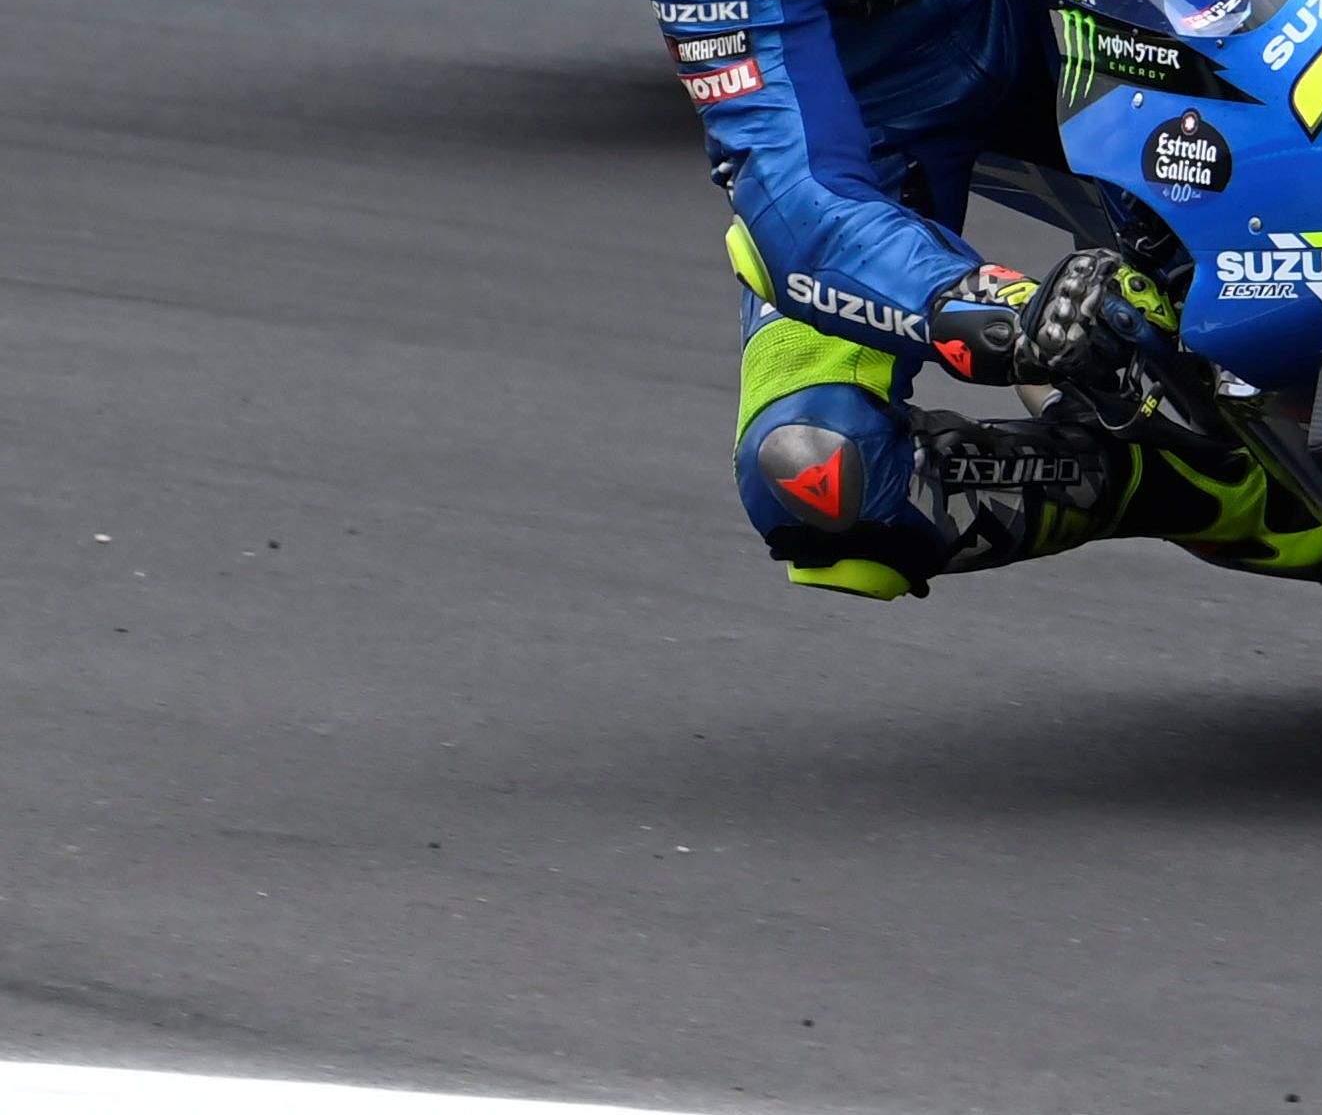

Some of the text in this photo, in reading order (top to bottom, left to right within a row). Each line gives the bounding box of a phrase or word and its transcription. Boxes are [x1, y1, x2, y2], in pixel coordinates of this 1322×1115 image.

[652, 0, 750, 23] SUZUKI
[1097, 33, 1181, 70] MONSTER
[1109, 62, 1167, 81] ENERGY
[1155, 132, 1218, 164] Estrella
[1155, 156, 1212, 186] Galicia
[1217, 282, 1298, 300] ECSTAR
[1140, 396, 1159, 419] 36
